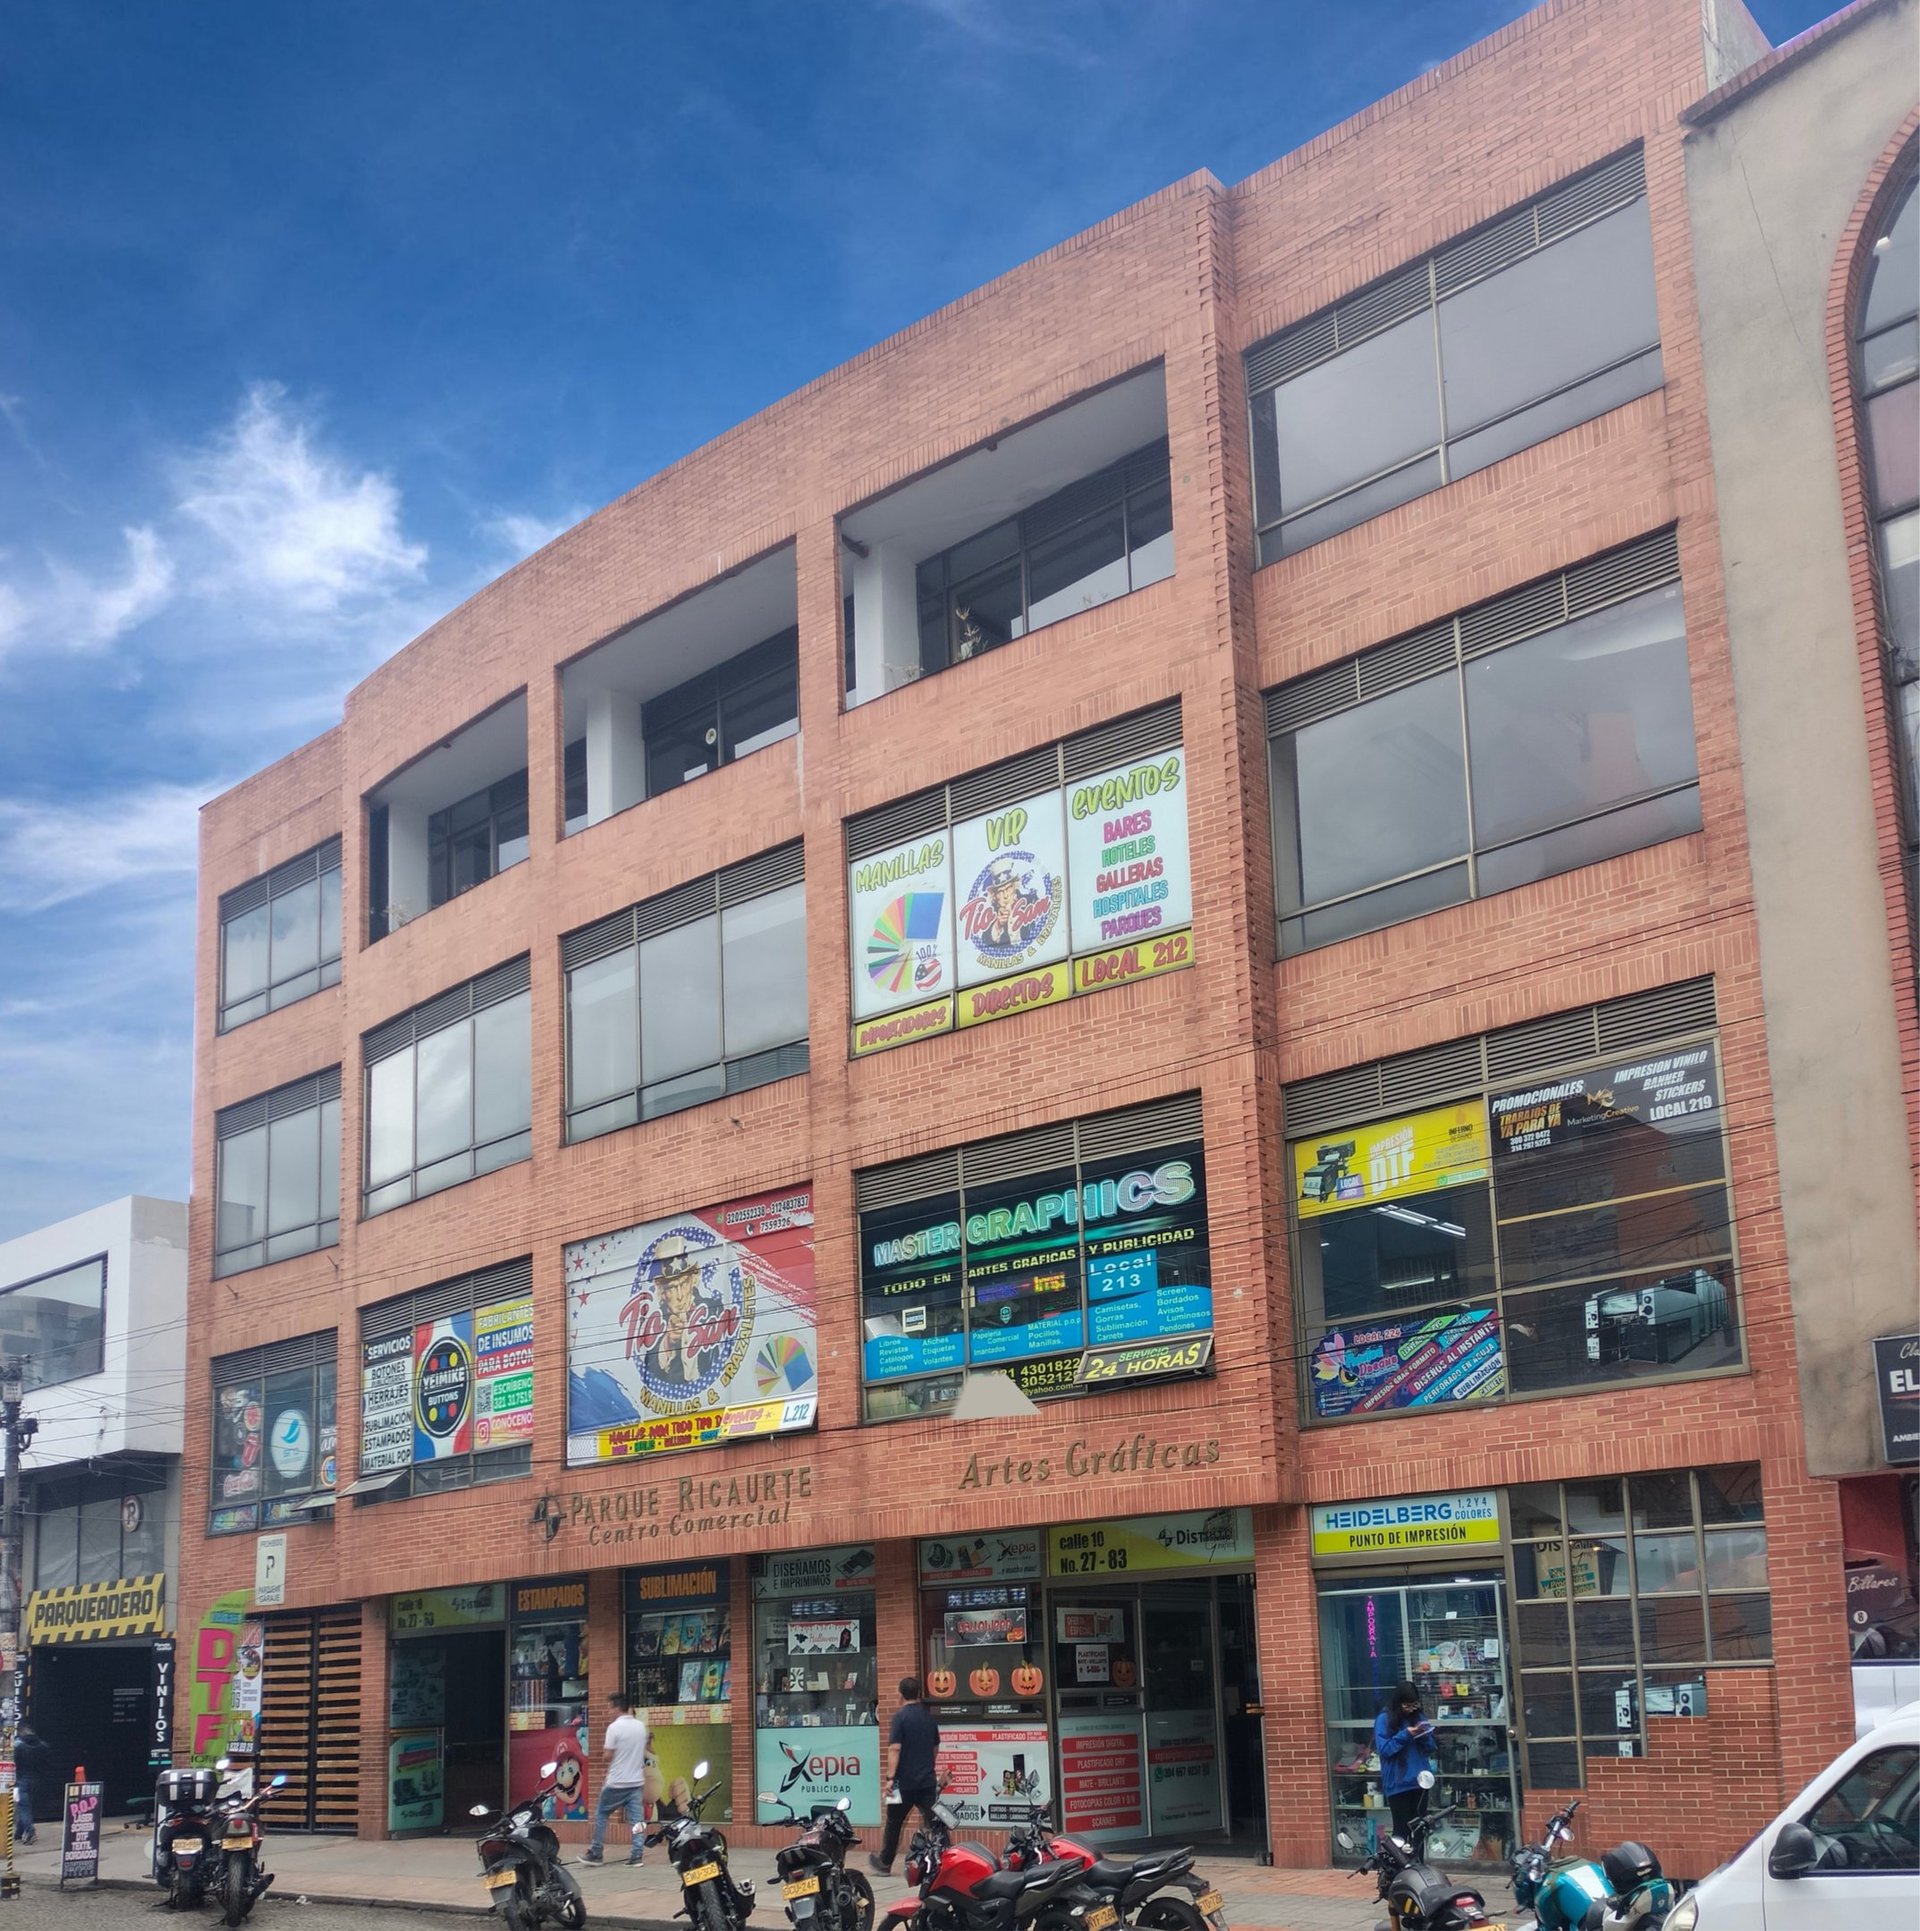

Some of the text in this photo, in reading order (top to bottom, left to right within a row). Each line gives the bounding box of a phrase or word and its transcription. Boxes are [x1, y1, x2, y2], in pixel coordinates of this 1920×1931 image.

[1103, 810, 1152, 843] BARES
[1101, 835, 1156, 868] HOTELES
[856, 839, 945, 893] MANILLAS
[1095, 856, 1164, 893] GALLERAS
[1093, 880, 1169, 919] HOSPITALES
[960, 896, 1051, 941] Tio Sam
[976, 875, 1062, 970] MANILLAS BRAZALETES
[1101, 906, 1162, 941] PARQUES
[1081, 936, 1188, 987] LOCAL 212
[971, 972, 1054, 1018] DIRECTOS
[1614, 1050, 1708, 1084] IMPRESION VINILO
[1642, 1070, 1685, 1091] BANNER
[1654, 1079, 1706, 1102] STICKERS
[1492, 1079, 1585, 1114] PROMOCIONALES
[1500, 1101, 1561, 1127] TRABAJOS DE
[1650, 1095, 1712, 1121] LOCAL 219
[1500, 1113, 1562, 1139] YA PARA YA
[1370, 1144, 1416, 1197] DTF
[873, 1161, 1197, 1268] MASTER GRAPHICS
[881, 1228, 1195, 1296] TODO EN ARTES GRAFICAS Y PUBLICIDAD
[1089, 1253, 1152, 1277] Local
[1101, 1274, 1142, 1292] 213
[1156, 1286, 1188, 1297] Screen
[1157, 1293, 1200, 1306] Bordados
[1157, 1305, 1185, 1315] Avisos
[619, 1292, 740, 1360] Tio Sam
[1027, 1319, 1062, 1331] MATERIAL
[1096, 1313, 1125, 1323] Gorras
[1096, 1318, 1148, 1332] Sublimación
[1166, 1309, 1211, 1322] Luminosos
[1097, 1332, 1124, 1342] Carnets
[1159, 1321, 1195, 1333] Pendones
[1354, 1328, 1401, 1344] LOCAL 224
[368, 1336, 411, 1360] SERVICIOS
[478, 1325, 534, 1352] DE INSUMOS
[640, 1386, 701, 1416] MANILLAS
[721, 1274, 756, 1387] BRAZALETES
[879, 1338, 901, 1348] Libros
[922, 1336, 949, 1346] Afiches
[922, 1343, 956, 1355] Etiquetas
[987, 1333, 1020, 1344] Comercial
[879, 1345, 909, 1356] Revistas
[879, 1352, 914, 1364] Catálogos
[923, 1355, 953, 1366] Volantes
[973, 1345, 1006, 1356] Imantados
[1084, 1342, 1202, 1381] 24 HORAS
[1118, 1347, 1169, 1363] SERVICIO
[1410, 1347, 1436, 1371] FORMATO
[1414, 1361, 1447, 1390] DISEÑOS
[1447, 1352, 1458, 1364] AL
[1458, 1321, 1496, 1354] INSTANTE
[371, 1360, 406, 1380] BOTONES
[423, 1366, 465, 1390] YEIMIKE
[478, 1359, 501, 1375] PARA
[880, 1364, 908, 1374] Folletos
[1424, 1344, 1495, 1403] PERFORADO EN AGUJA
[368, 1384, 409, 1405] HERRAJES
[428, 1391, 459, 1405] BUTTONS
[365, 1411, 412, 1433] SUBLIMACIÓN
[783, 1403, 810, 1423] L.212
[365, 1429, 411, 1451] ESTAMPADOS
[363, 1449, 411, 1471] MATERIAL POP
[958, 1432, 1221, 1489] Artes Gráficas
[570, 1466, 812, 1526] PARQUE RICAURTE
[589, 1502, 792, 1546] Centro Comercial
[1326, 1496, 1487, 1530] HEIDELBERG 2 Y 4
[1455, 1508, 1492, 1520] COLORES
[1059, 1530, 1104, 1549] calle 10
[1350, 1523, 1467, 1548] PUNTO DE IMPRESIÓN
[773, 1557, 831, 1578] DISEÑAMOS
[1060, 1549, 1127, 1574] No. 27 83
[639, 1566, 717, 1601] SUBLIMACIÓN
[773, 1573, 831, 1590] E IMPRIMIMOS
[33, 1587, 154, 1630] PARQUEADERO
[517, 1584, 585, 1612] ESTAMPADOS
[194, 1627, 235, 1755] DTF
[155, 1663, 168, 1742] VINILOS
[1106, 1738, 1126, 1748] DIGITAL
[779, 1740, 860, 1793] Xepia
[1077, 1759, 1113, 1769] PLASTIFICADO
[801, 1785, 851, 1793] PUBLICIDAD
[1079, 1776, 1125, 1789] MATE BRILLANTE
[70, 1797, 97, 1816] P.O.P
[1070, 1797, 1102, 1810] FOTOCOPIAS
[71, 1822, 95, 1833] SCREEN
[73, 1813, 93, 1823] LASER
[1092, 1817, 1116, 1828] SCANNER
[72, 1841, 92, 1850] TEXTIL
[76, 1831, 88, 1841] DTF
[65, 1849, 97, 1860] BORDADOS
